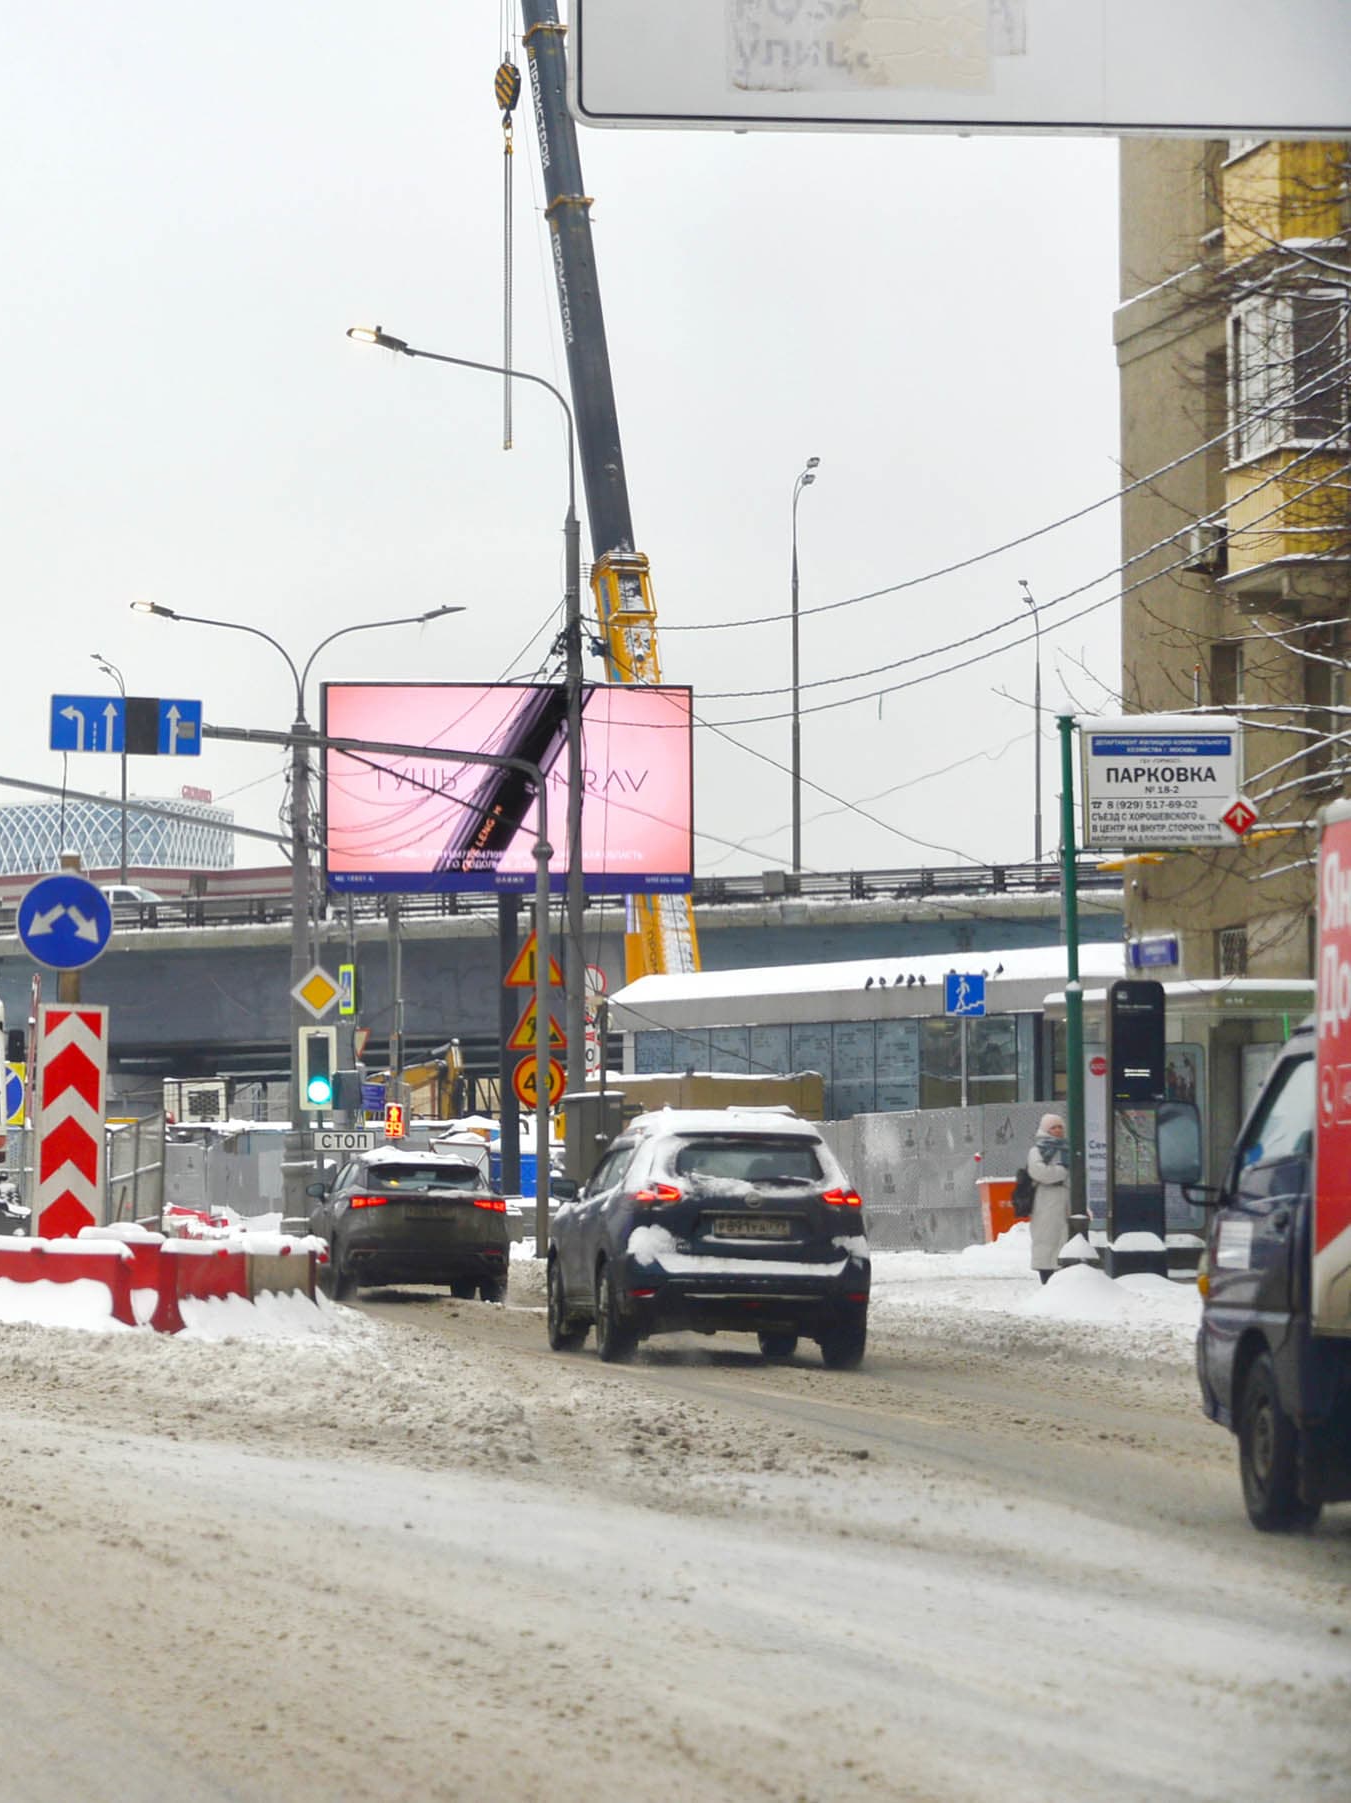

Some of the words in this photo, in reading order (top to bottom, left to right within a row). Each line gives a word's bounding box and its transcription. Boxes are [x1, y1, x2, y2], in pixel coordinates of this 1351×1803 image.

[1106, 767, 1217, 783] ПАРКОВКА
[1157, 785, 1179, 793] 18-2
[1106, 801, 1114, 809] 8
[1116, 801, 1143, 809] (929)
[1091, 813, 1120, 822] СЪЕЗД
[1122, 813, 1127, 821] С
[1129, 812, 1197, 821] ХОРОШЕВСКОГО
[1092, 824, 1098, 833] В
[1099, 824, 1125, 834] ЦЕНТР
[1127, 824, 1138, 832] НА
[321, 1134, 367, 1149] СТОП
